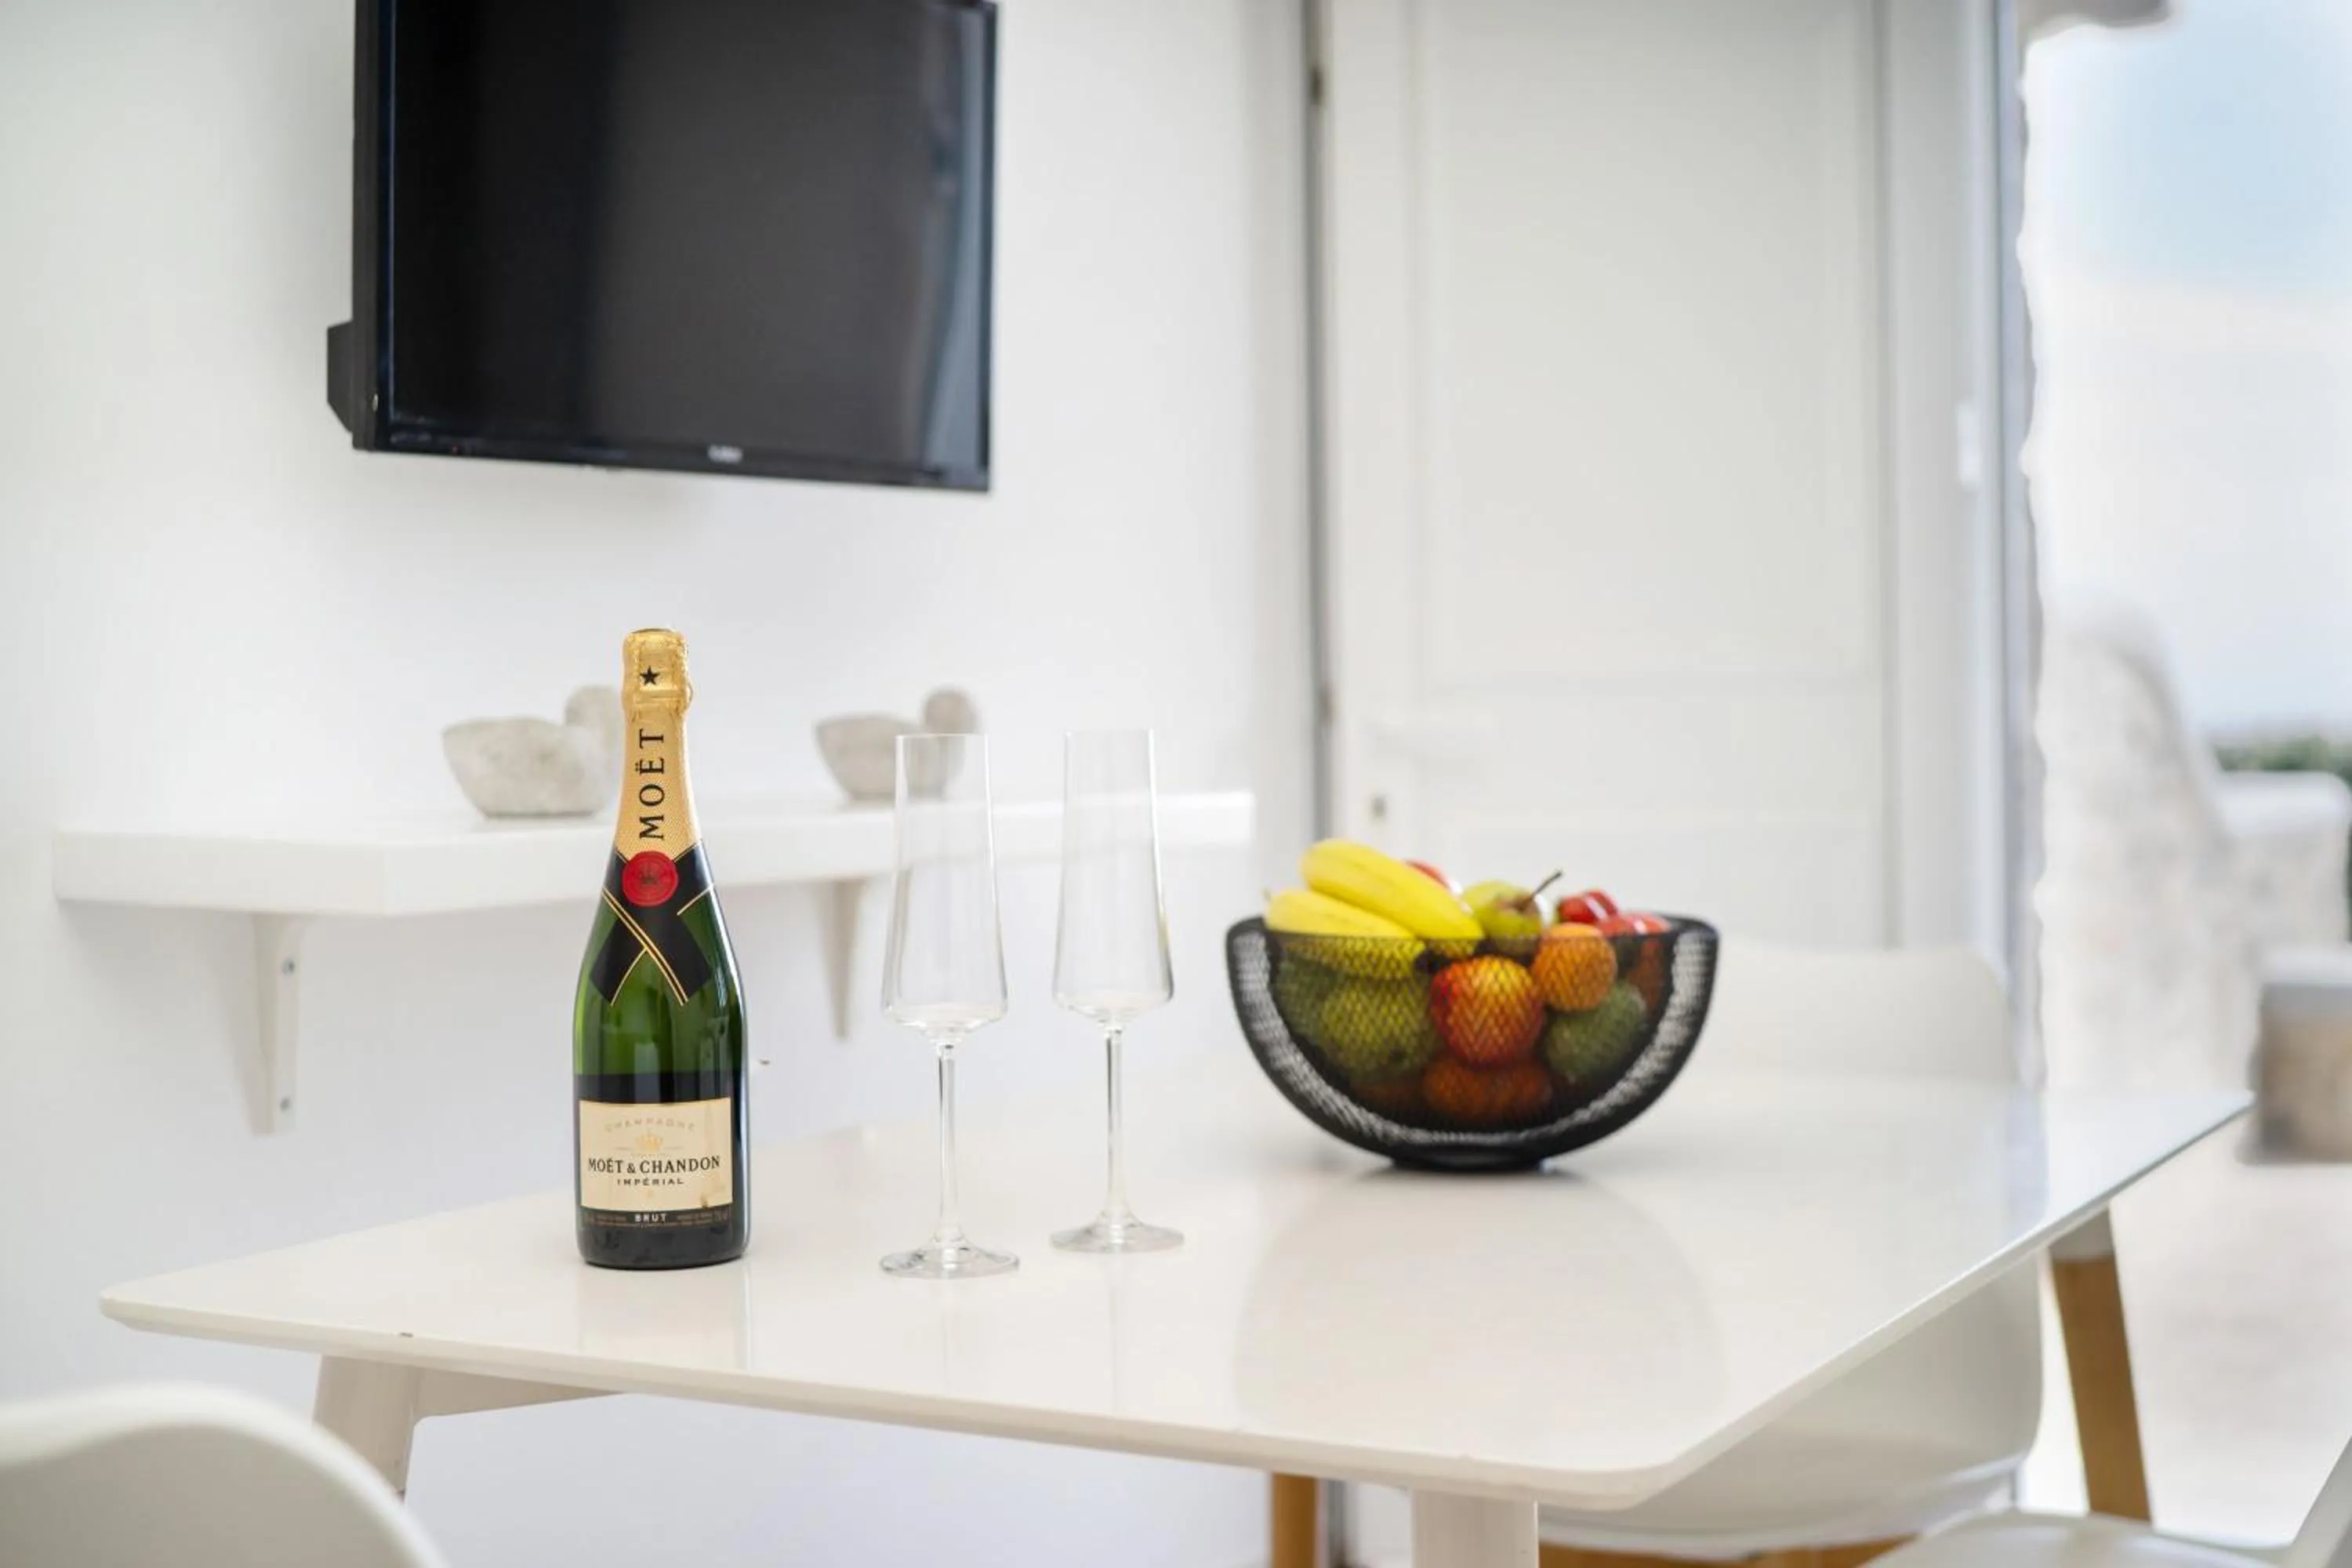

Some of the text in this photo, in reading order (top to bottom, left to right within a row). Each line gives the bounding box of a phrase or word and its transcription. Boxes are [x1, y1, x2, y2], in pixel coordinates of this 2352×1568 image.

[634, 728, 666, 840] MOËT
[626, 1162, 637, 1174] &
[639, 1155, 720, 1174] CHANDON
[634, 1213, 666, 1223] BRUT
